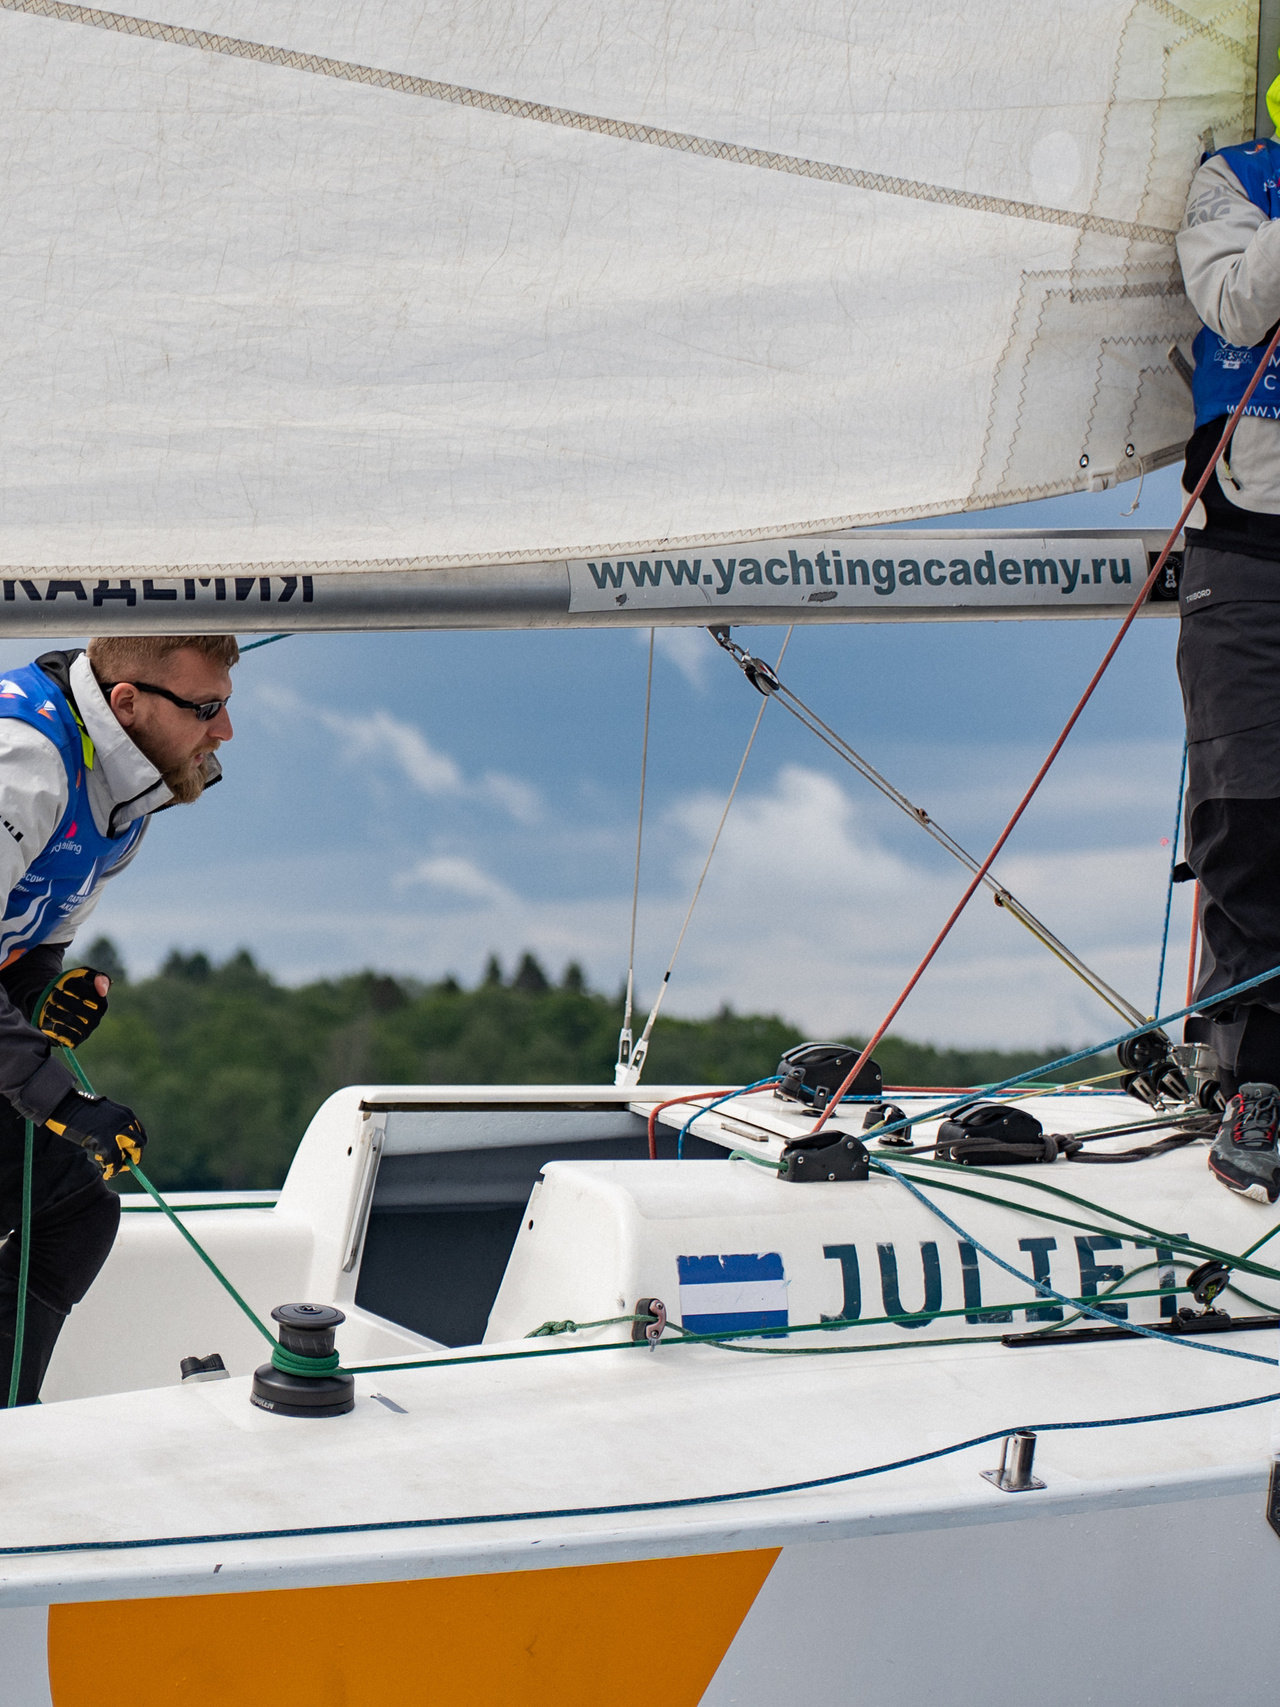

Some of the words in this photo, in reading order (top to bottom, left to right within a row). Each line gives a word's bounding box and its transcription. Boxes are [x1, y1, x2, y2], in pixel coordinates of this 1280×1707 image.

[587, 549, 1132, 595] www.yachtingacademy.ru
[1185, 588, 1212, 603] TRIBORD
[820, 1232, 1190, 1332] JULIET
